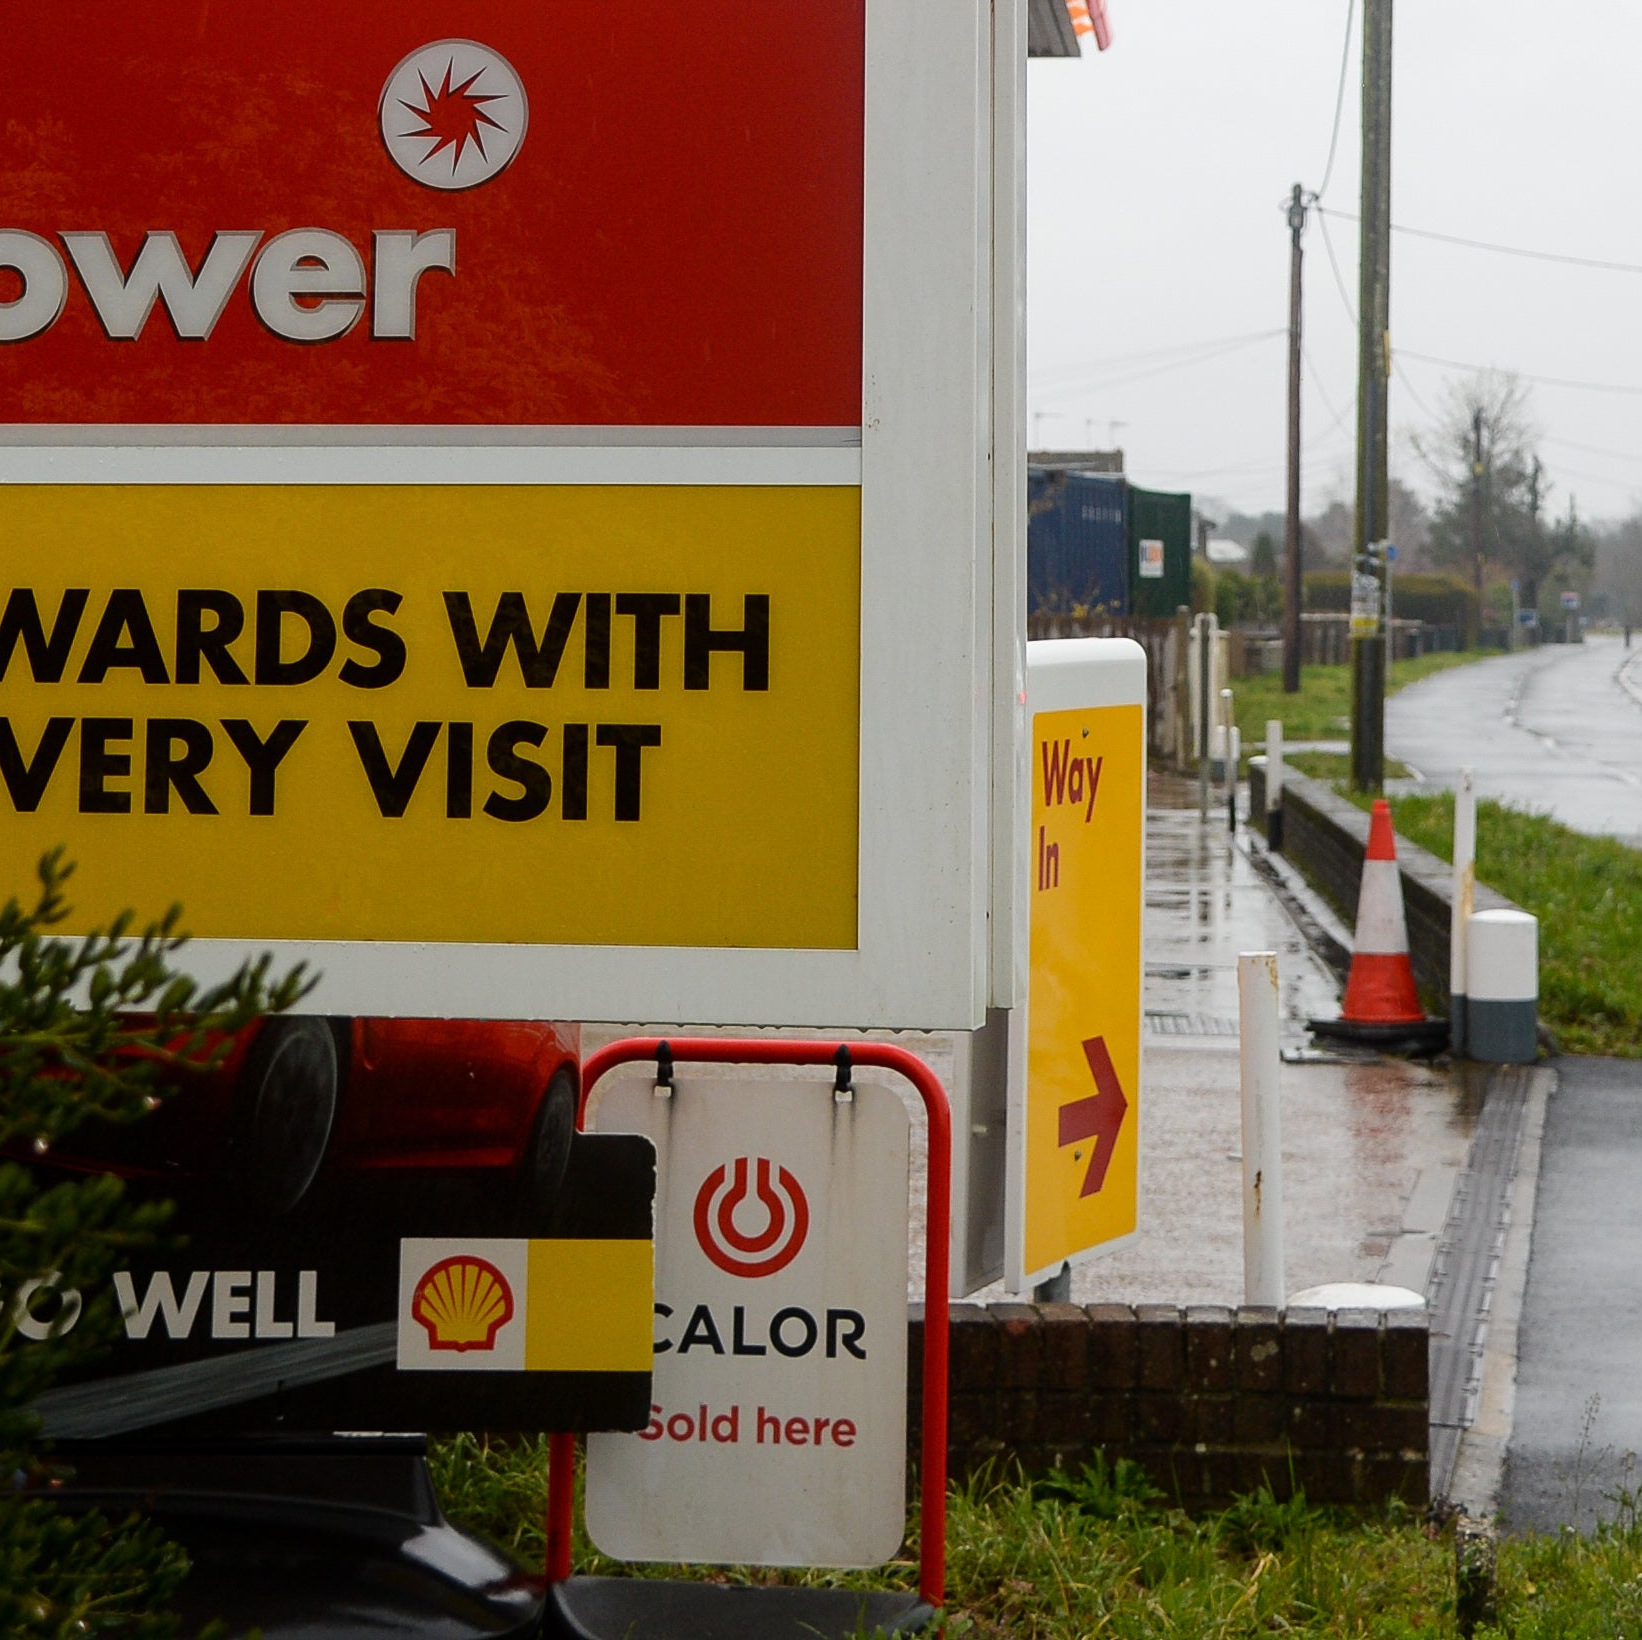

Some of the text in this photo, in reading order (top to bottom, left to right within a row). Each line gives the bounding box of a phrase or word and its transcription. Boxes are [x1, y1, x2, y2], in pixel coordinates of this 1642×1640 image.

[442, 591, 771, 692] WITH
[347, 720, 662, 823] VISIT
[1042, 738, 1103, 824] Way
[1038, 824, 1059, 892] In
[113, 1269, 336, 1339] WELL
[757, 1406, 857, 1448] here
